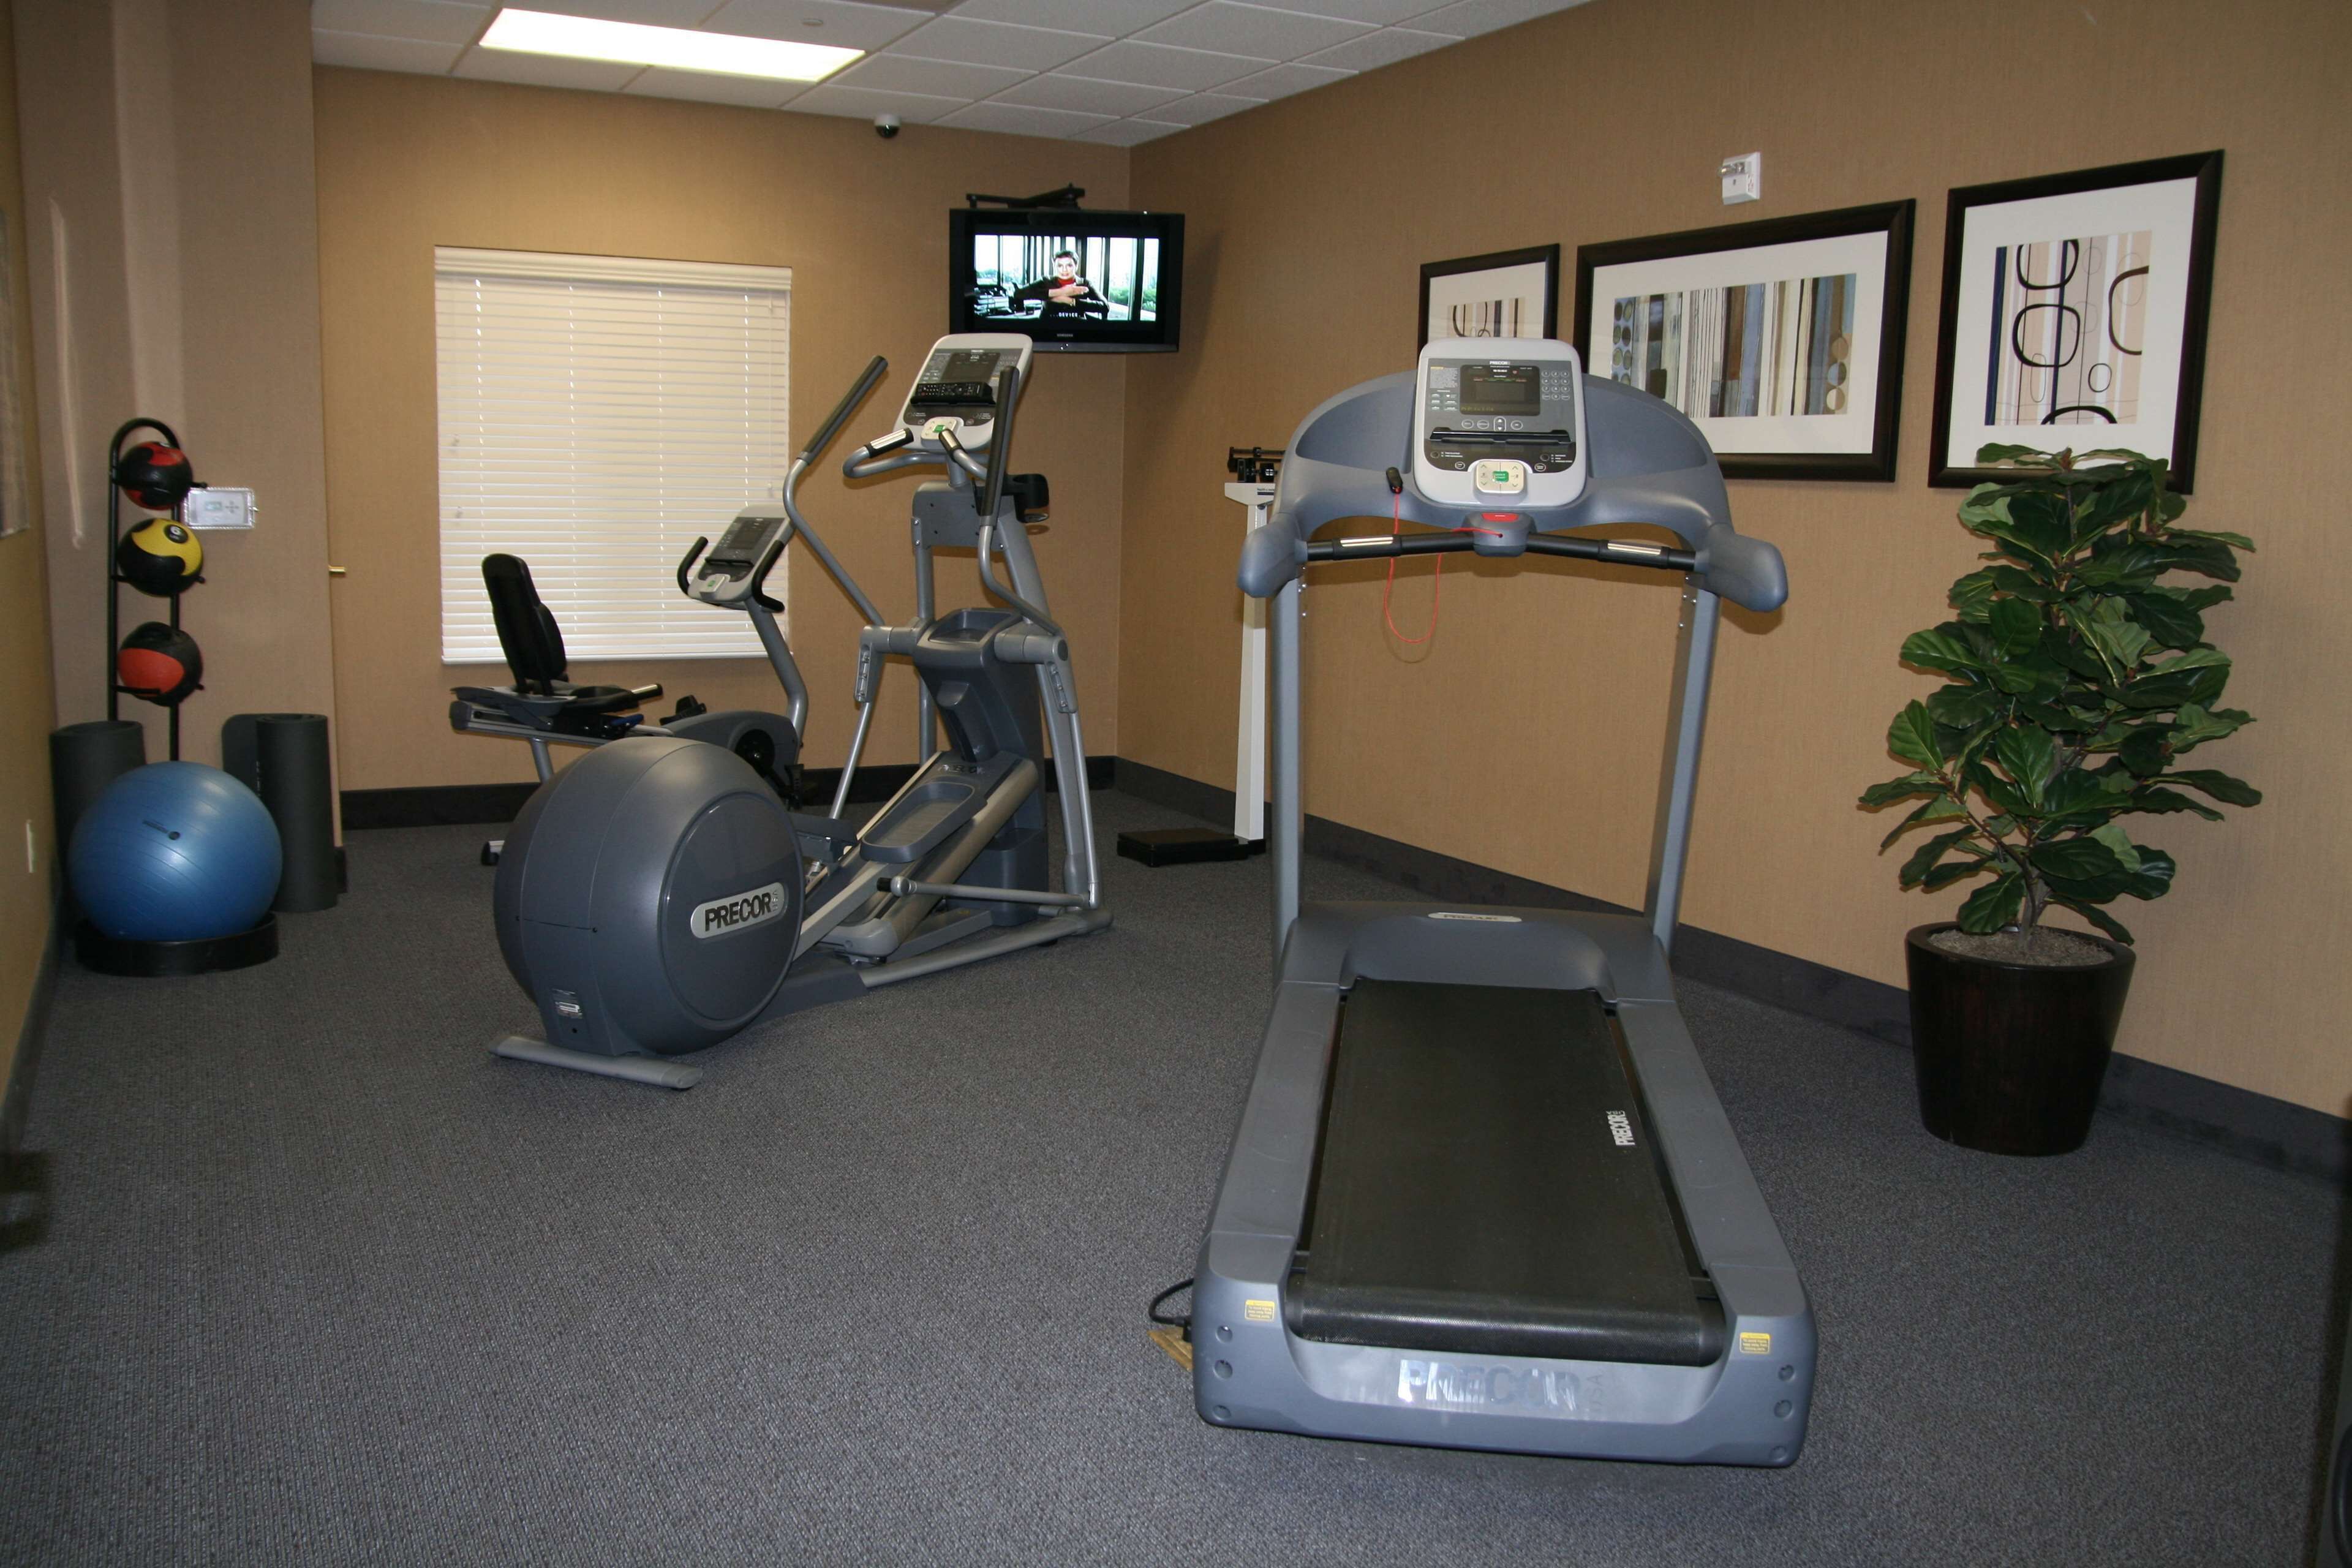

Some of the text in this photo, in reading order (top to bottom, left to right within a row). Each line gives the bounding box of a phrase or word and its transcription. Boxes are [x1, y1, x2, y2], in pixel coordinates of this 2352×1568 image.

[170, 526, 182, 535] 6
[705, 892, 772, 932] PRECOR
[1607, 1114, 1635, 1146] PRECOR
[1398, 1359, 1580, 1411] PRECOR
